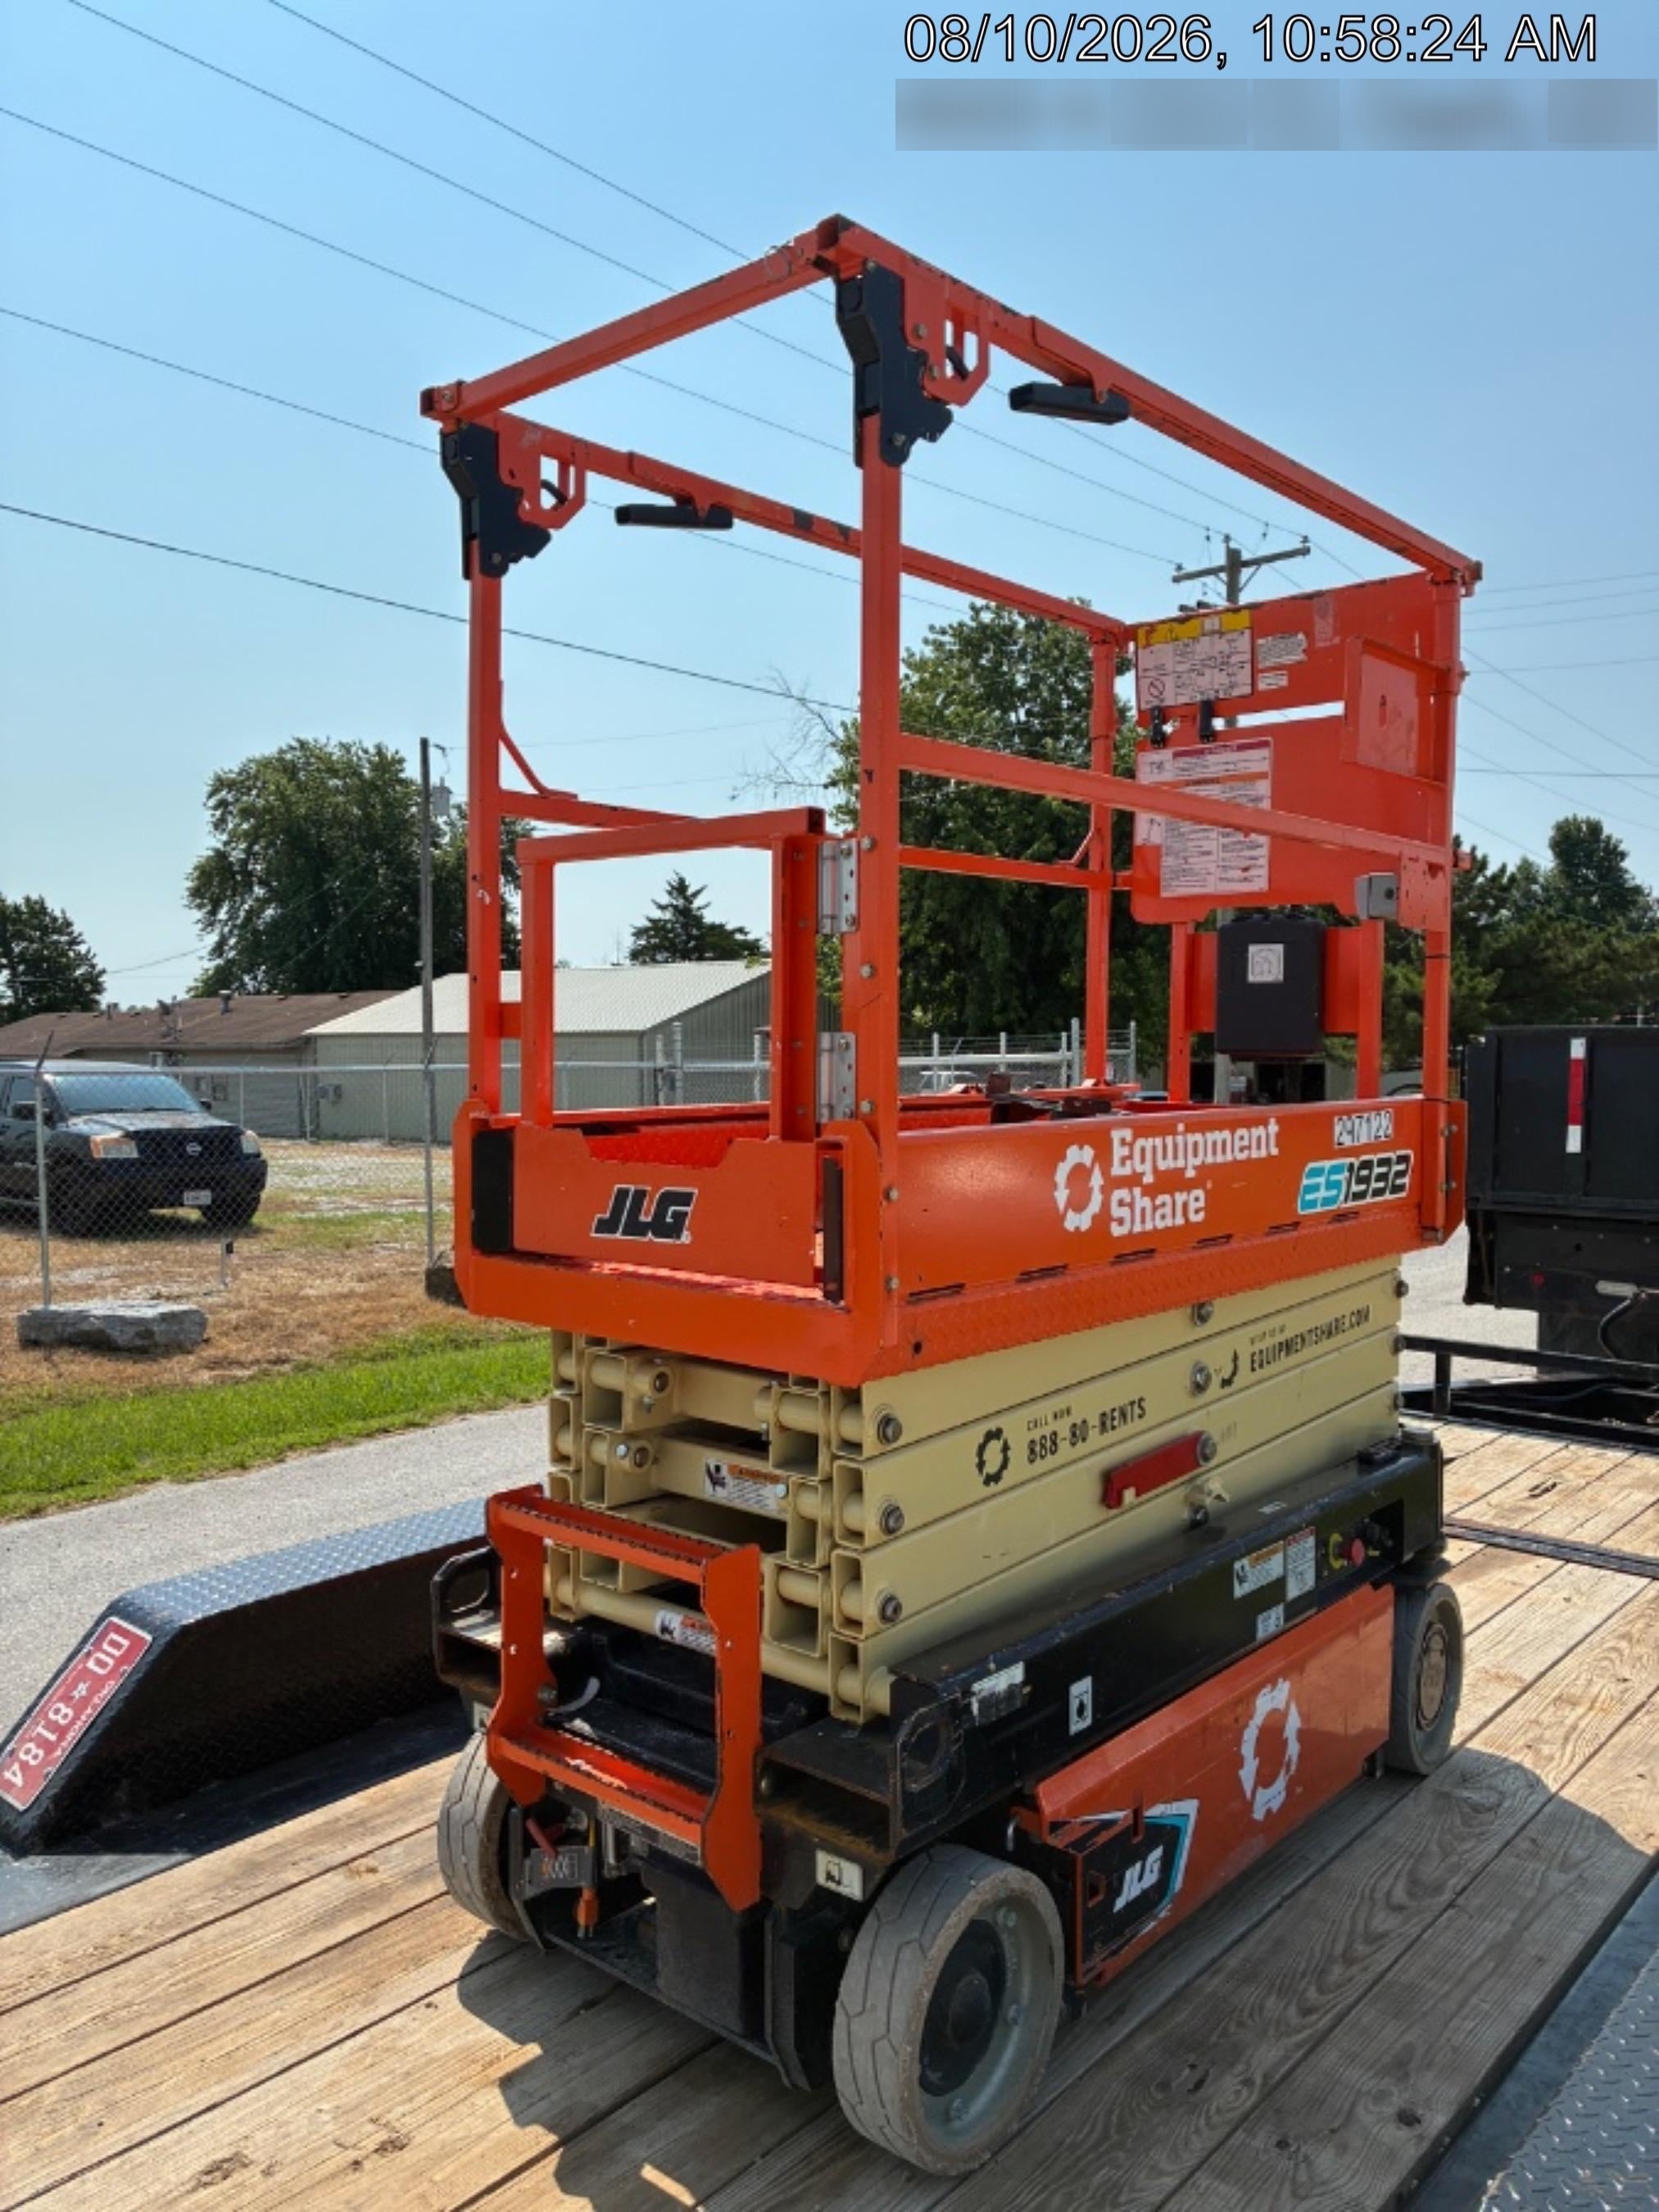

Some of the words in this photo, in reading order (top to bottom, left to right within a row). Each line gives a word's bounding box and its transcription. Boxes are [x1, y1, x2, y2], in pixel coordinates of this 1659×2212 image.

[1110, 1118, 1280, 1183] Equipment
[1336, 1111, 1392, 1146] 247122
[590, 1184, 699, 1244] JLG
[1110, 1187, 1206, 1238] Share
[1298, 1150, 1413, 1214] ES1932
[1250, 1304, 1371, 1372] EQUIPMENTSHARE.COM
[1027, 1395, 1147, 1465] 888-80-RENTS
[2, 1702, 75, 1788] 8184
[1113, 1845, 1163, 1915] JLG
